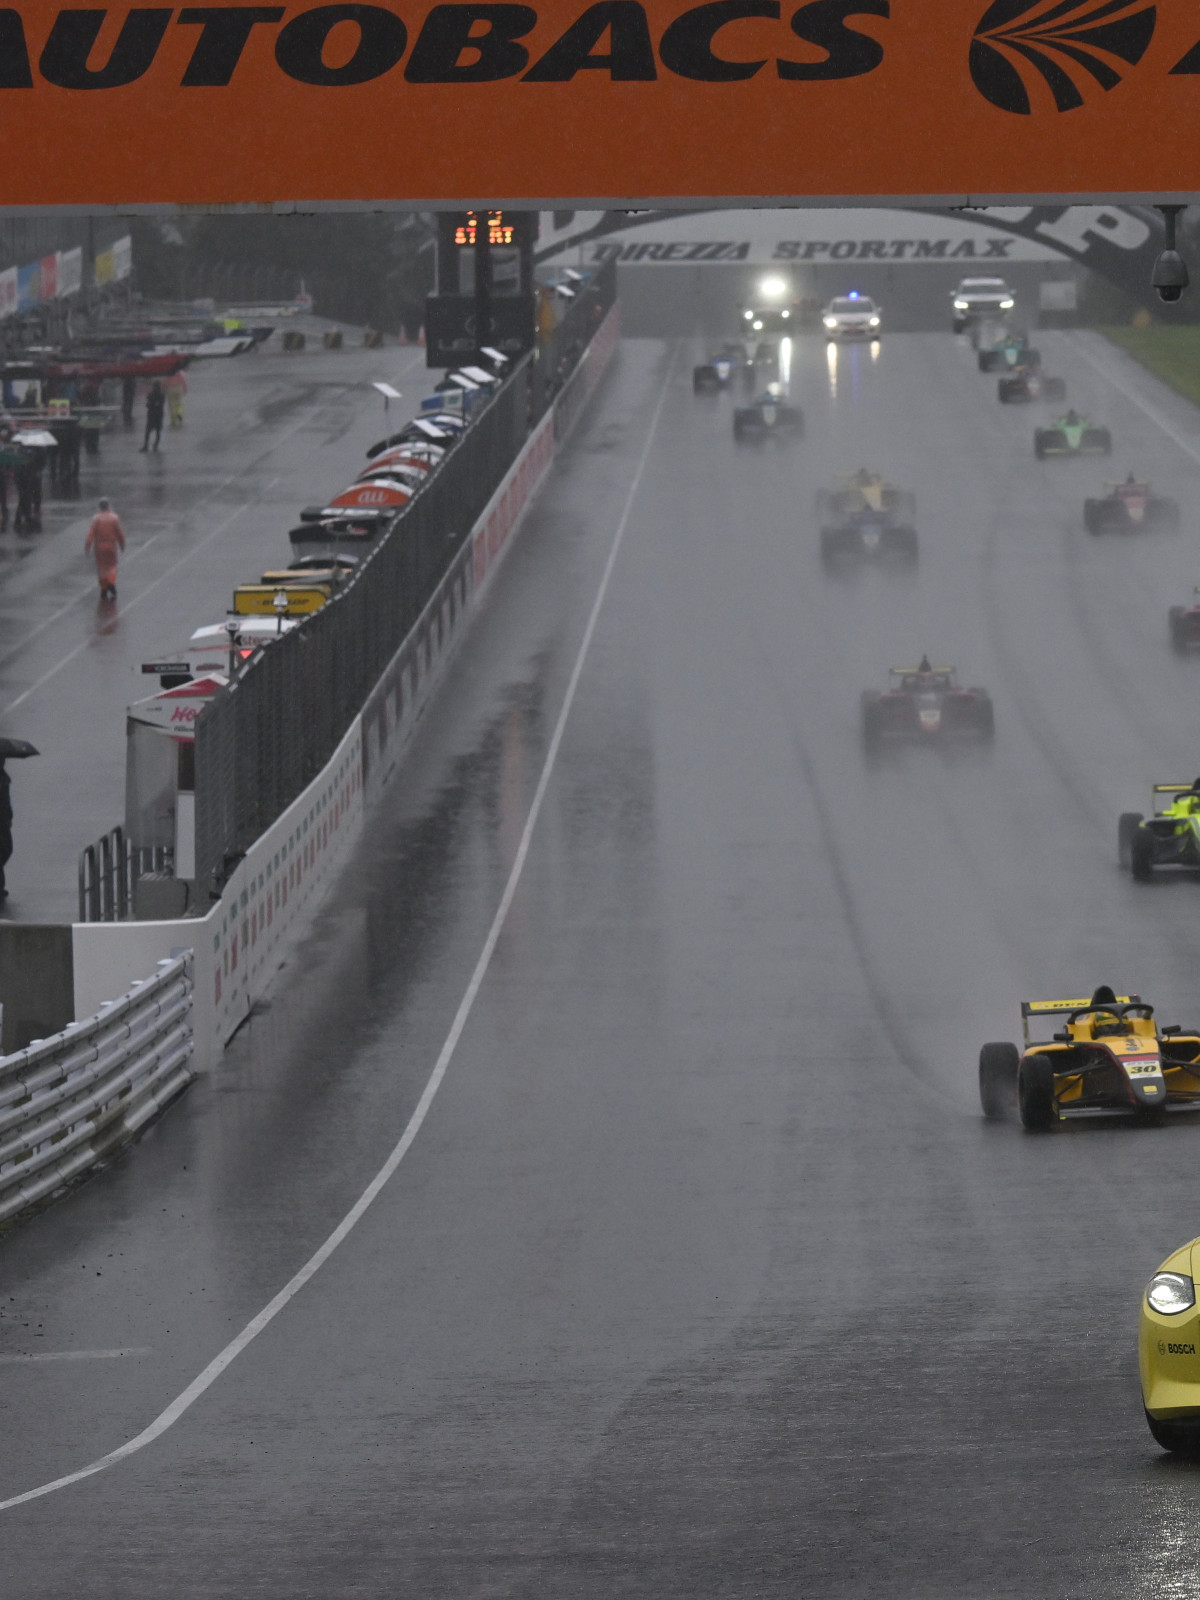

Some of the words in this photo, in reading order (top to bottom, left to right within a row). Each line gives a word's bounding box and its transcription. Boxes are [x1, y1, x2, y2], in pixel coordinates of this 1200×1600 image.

[0, 0, 891, 90] UTOBACS
[590, 240, 751, 261] DIREZZA
[771, 239, 1016, 260] SPORTMAX
[358, 490, 388, 503] au
[1130, 1064, 1158, 1075] 30
[1168, 1343, 1196, 1355] BOSCH
